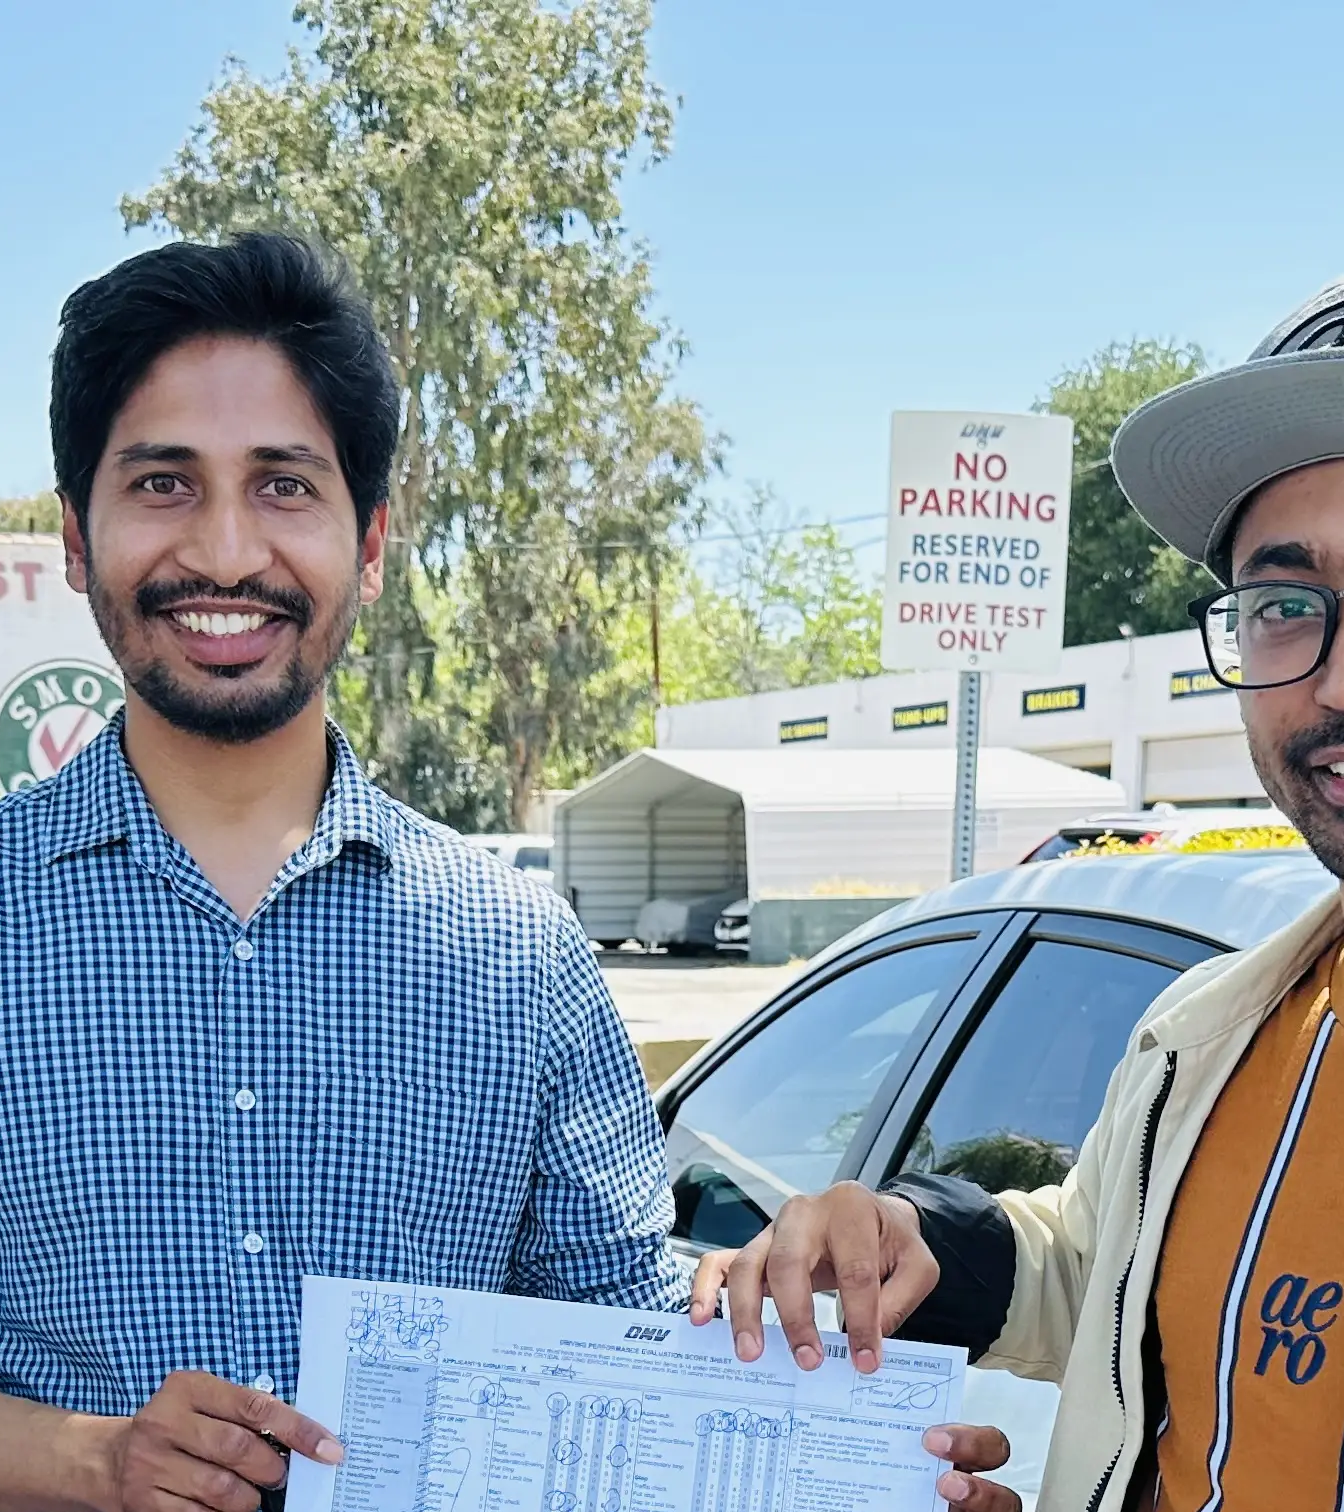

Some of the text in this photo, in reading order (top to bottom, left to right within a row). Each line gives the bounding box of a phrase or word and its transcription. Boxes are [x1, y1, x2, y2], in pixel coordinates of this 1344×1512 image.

[954, 452, 1007, 482] NO
[899, 488, 1057, 522] PARKING
[912, 534, 1040, 560] RESERVED
[898, 562, 1052, 589] FOR END OF
[899, 603, 1047, 629] DRIVE TEST
[938, 630, 1008, 651] ONLY
[1260, 1273, 1344, 1333] ae
[623, 1325, 672, 1341] DMV
[1254, 1325, 1326, 1385] ro
